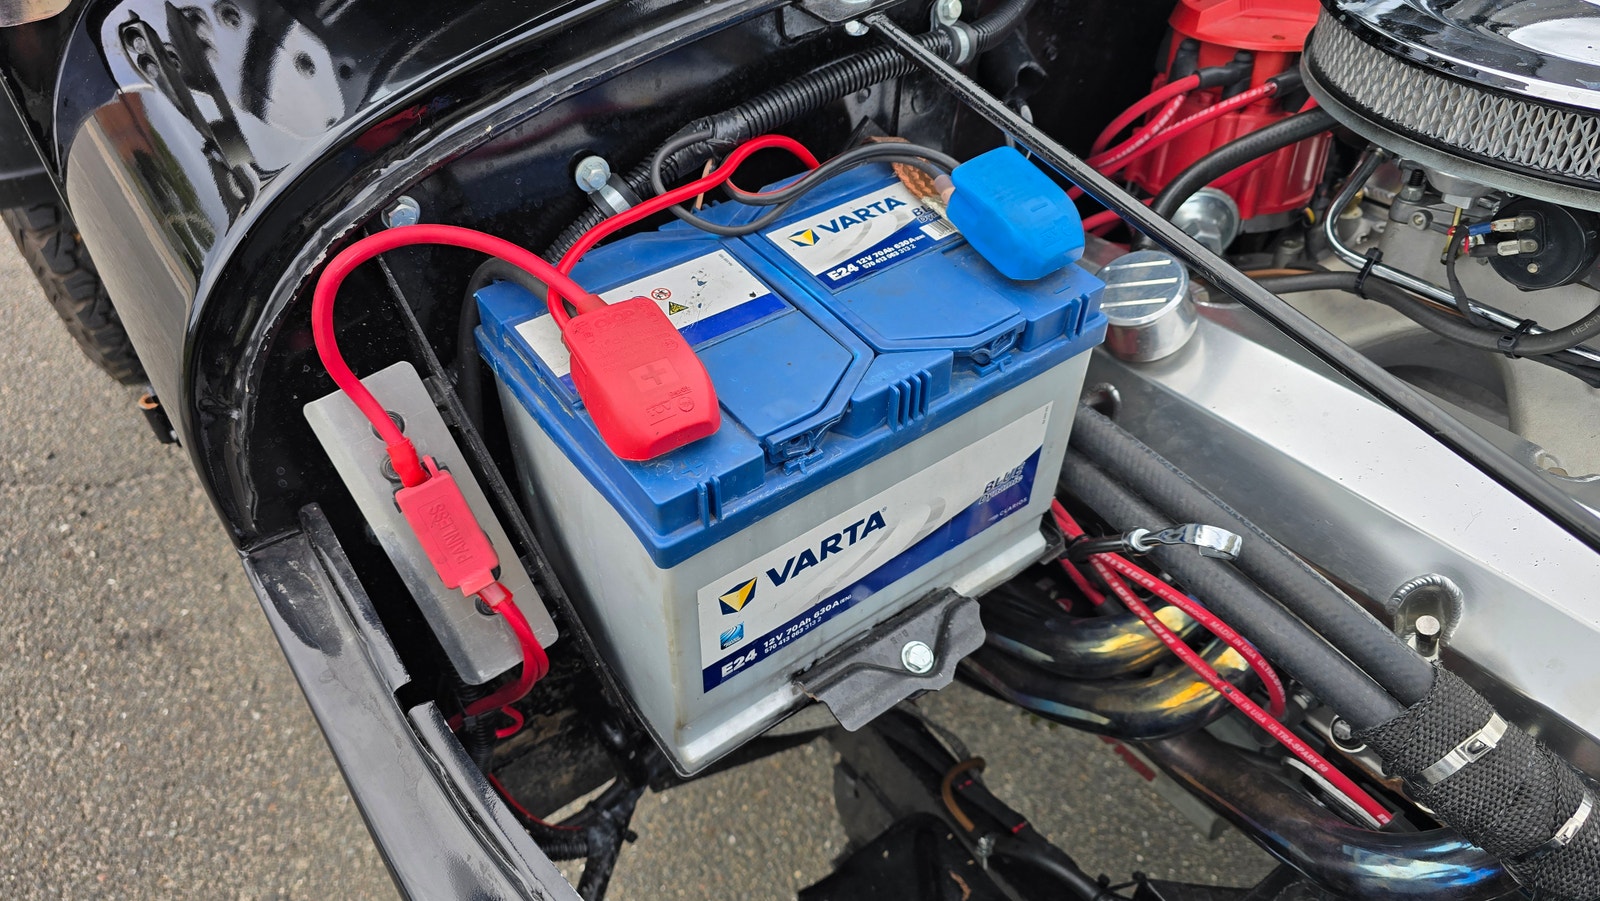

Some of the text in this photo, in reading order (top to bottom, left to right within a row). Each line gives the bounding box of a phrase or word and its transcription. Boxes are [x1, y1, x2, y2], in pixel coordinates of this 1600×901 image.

[817, 198, 907, 233] VARTA
[912, 204, 932, 217] BL
[826, 263, 860, 281] E24
[856, 255, 873, 266] 12V
[872, 247, 894, 259] 70Ah
[911, 243, 916, 251] 2
[1570, 313, 1600, 336] HERT
[984, 461, 1026, 494] BLUE
[999, 497, 1028, 516] CLARIOS
[429, 504, 473, 565] PAINLESS
[765, 510, 887, 587] VARTA
[721, 648, 758, 678] E24
[763, 633, 784, 648] 12V
[786, 617, 812, 635] 70Ah
[764, 642, 777, 654] 570
[778, 635, 791, 648] 413
[791, 628, 804, 640] 063
[804, 620, 817, 633] 313
[1210, 620, 1235, 642] MADE
[1232, 636, 1243, 647] IN
[1241, 643, 1257, 660] USA
[1241, 699, 1252, 711] IN
[1250, 708, 1267, 723] USA
[1268, 723, 1320, 765] ULTRA-SPARK
[1317, 762, 1329, 772] 50
